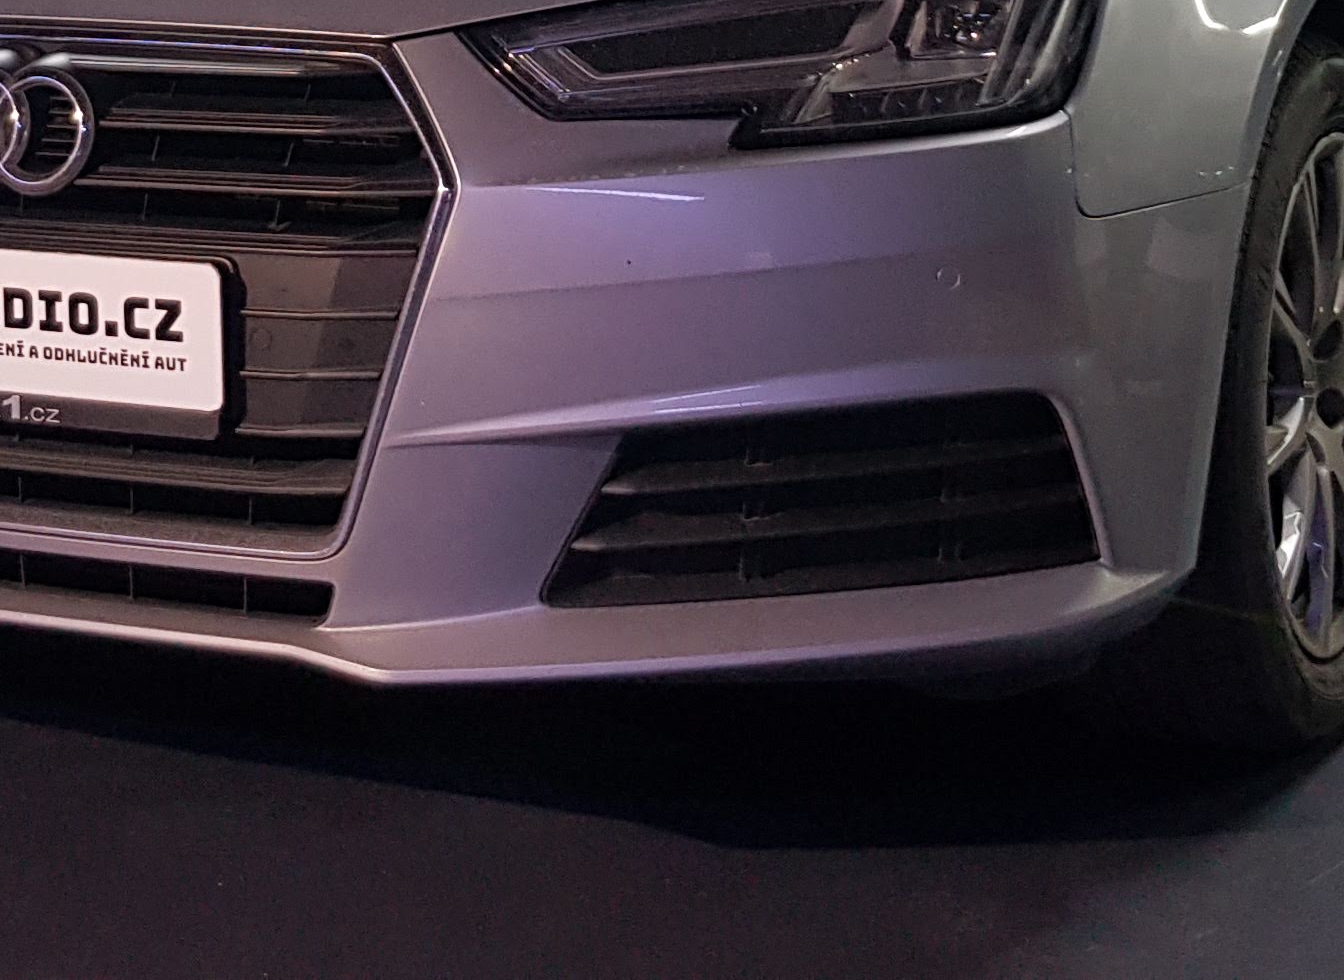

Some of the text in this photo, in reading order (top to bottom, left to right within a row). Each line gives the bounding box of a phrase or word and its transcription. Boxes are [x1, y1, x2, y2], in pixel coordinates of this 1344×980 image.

[29, 345, 39, 359] A
[43, 346, 150, 369] ODHLUČNĚNÍ
[155, 355, 187, 371] AUT
